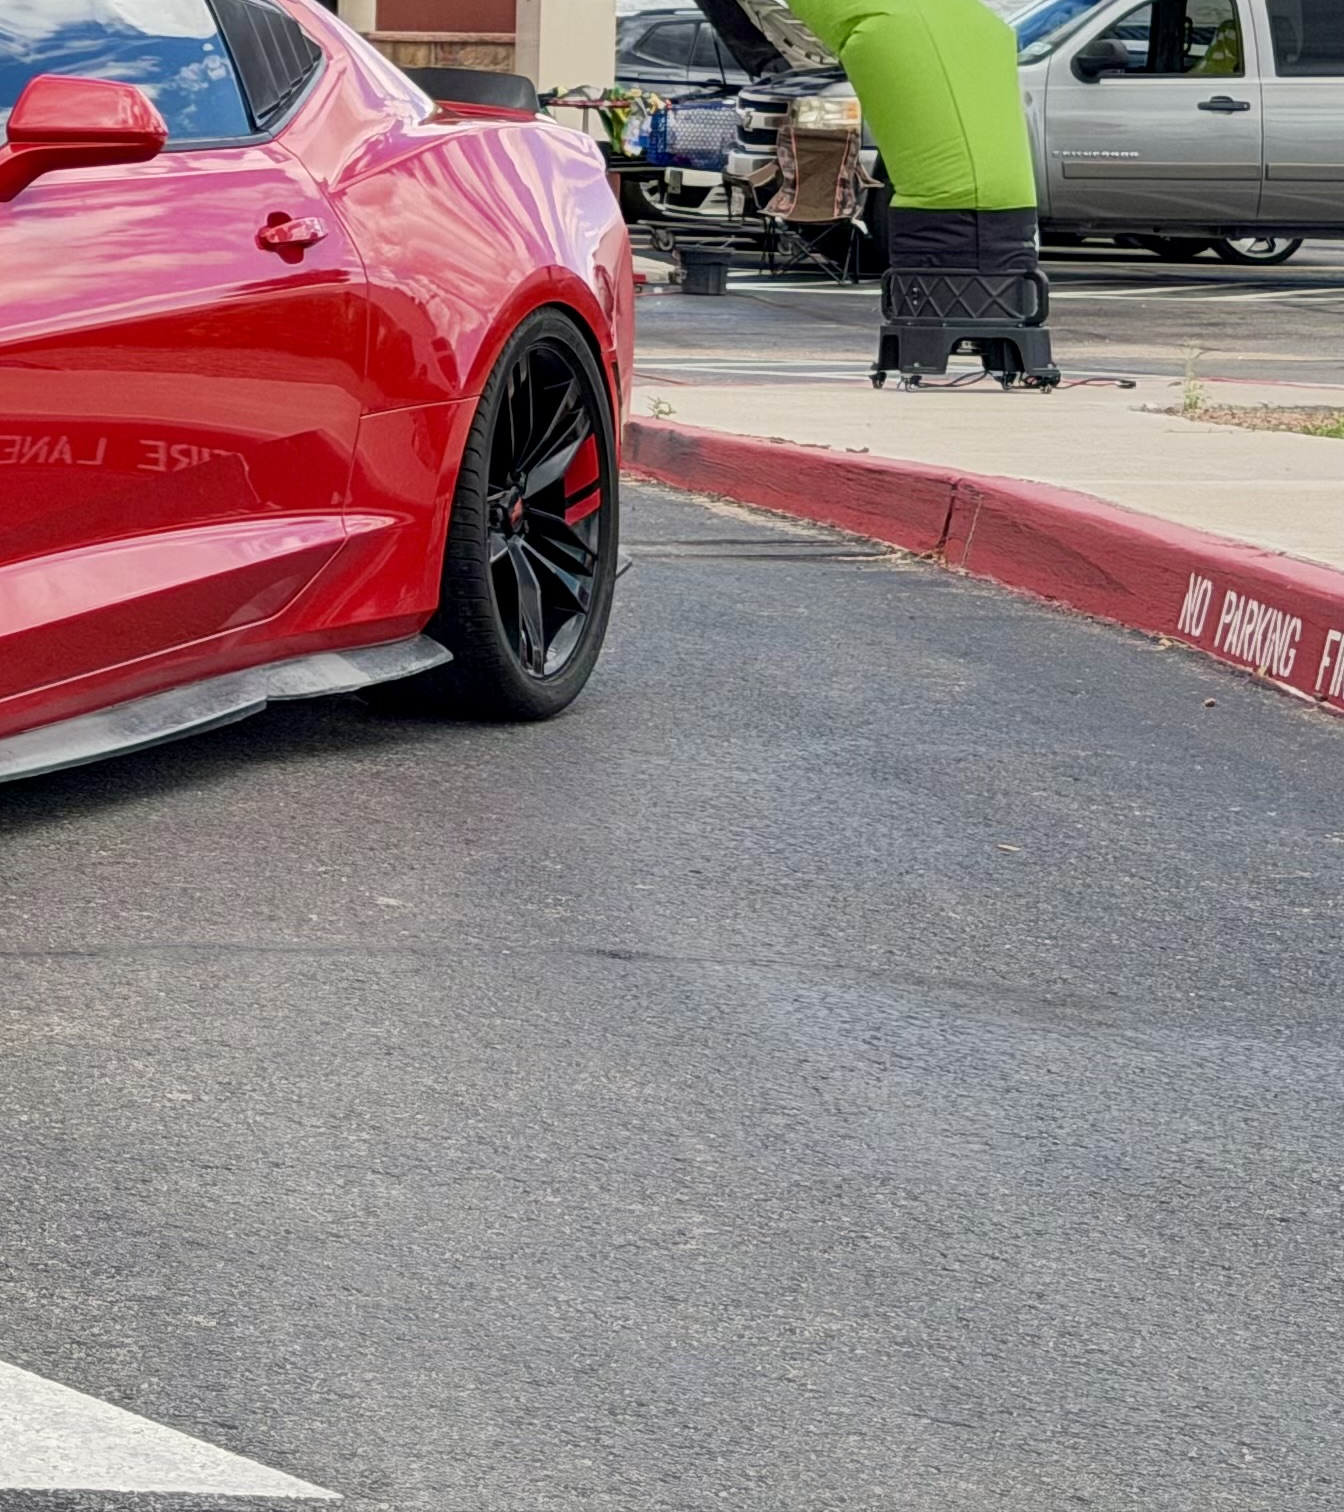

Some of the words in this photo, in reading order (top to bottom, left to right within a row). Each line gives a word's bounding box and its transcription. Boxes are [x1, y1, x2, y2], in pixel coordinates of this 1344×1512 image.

[1178, 571, 1213, 637] NO
[1214, 589, 1302, 678] PARKING
[1315, 628, 1344, 702] FI
